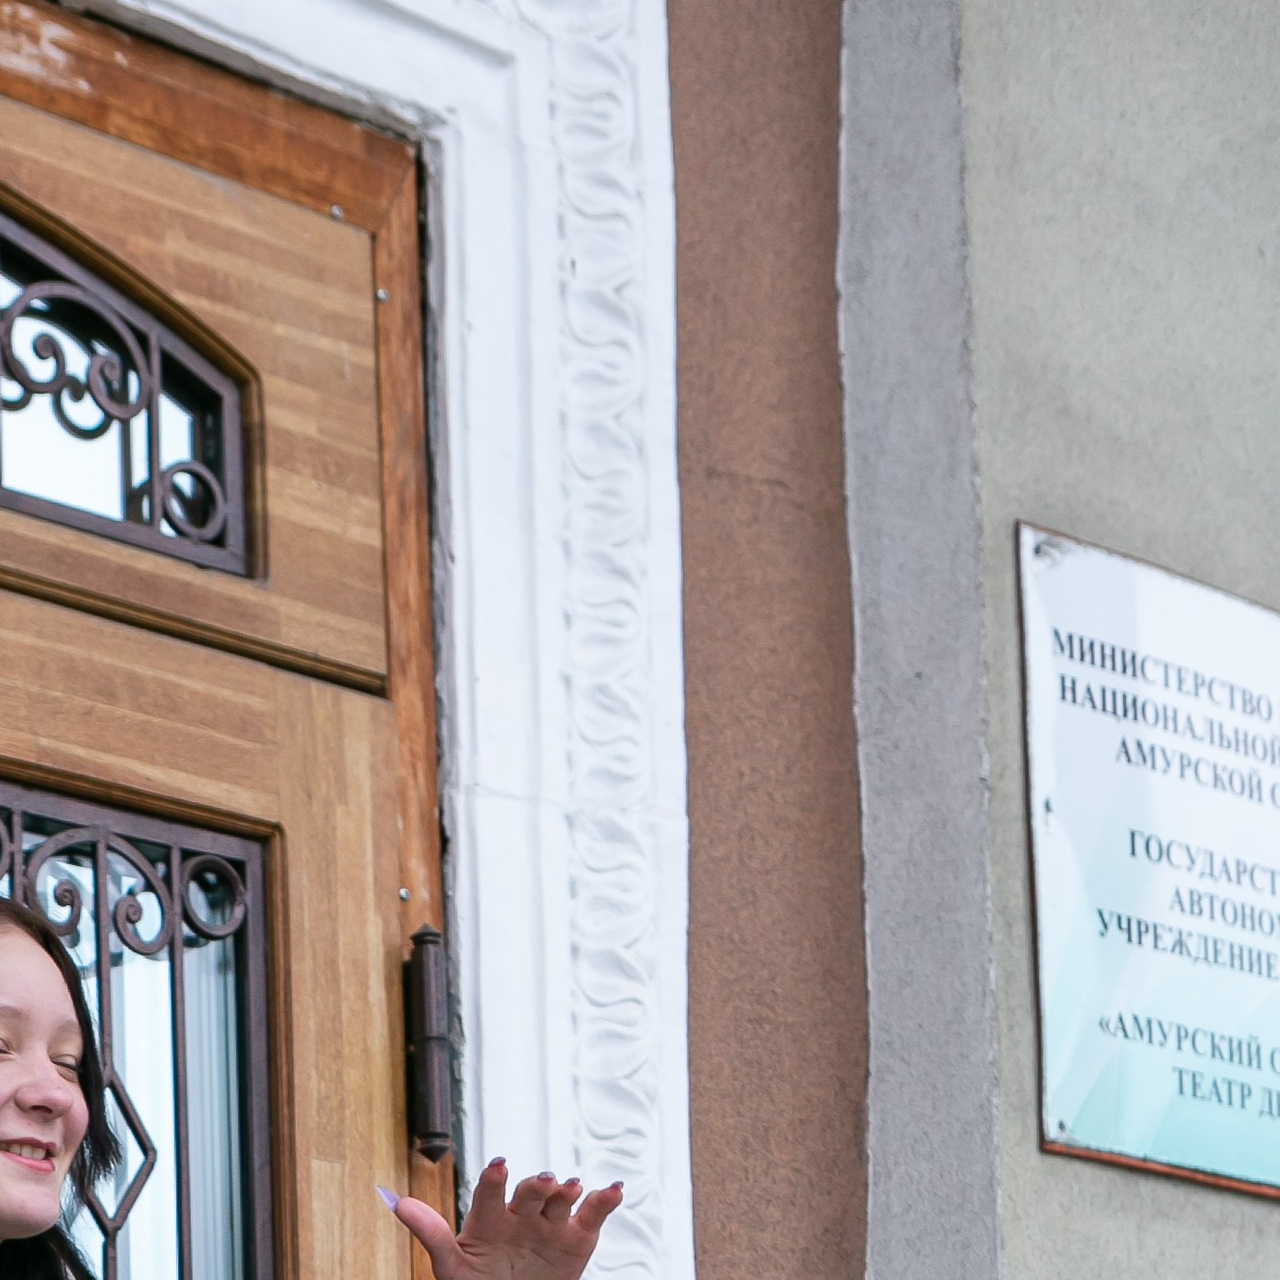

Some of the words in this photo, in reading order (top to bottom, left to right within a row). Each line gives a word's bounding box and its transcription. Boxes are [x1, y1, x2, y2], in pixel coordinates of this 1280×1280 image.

[1052, 626, 1272, 722] МИНИСТЕРСТВО
[1116, 736, 1263, 803] АМУРСКОЙ
[1170, 887, 1280, 937] АВТОНО
[1096, 909, 1280, 981] УЧРЕЖДЕНИЕ
[1099, 1011, 1262, 1071] «АМУРСКИЙ
[1173, 1067, 1253, 1109] ТЕАТР
